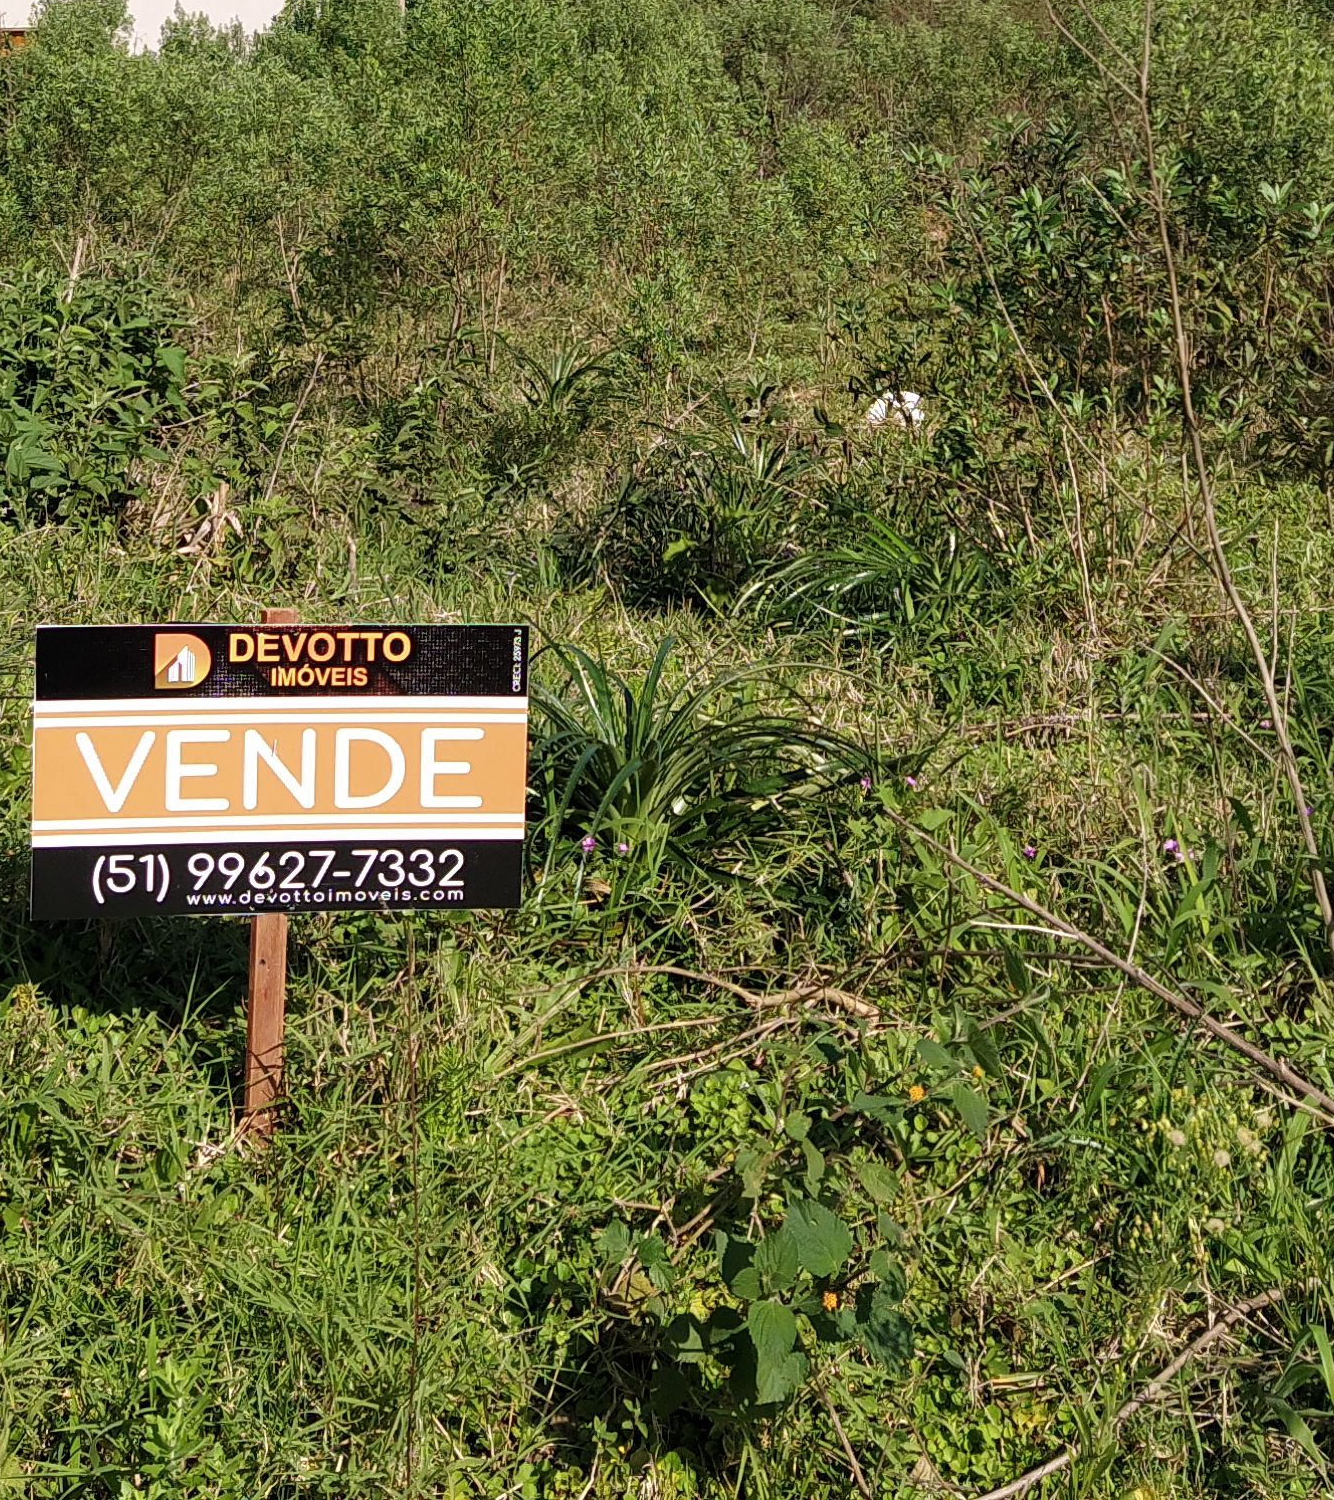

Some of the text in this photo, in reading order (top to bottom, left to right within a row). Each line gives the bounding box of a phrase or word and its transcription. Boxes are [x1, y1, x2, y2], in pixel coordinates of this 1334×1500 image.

[228, 631, 412, 663] DEVOTTO
[270, 664, 368, 687] IMÓVEIS
[75, 727, 485, 813] VENDE
[91, 848, 465, 904] (51) 99627-7332
[187, 887, 465, 906] www.devottoimoveis.com
